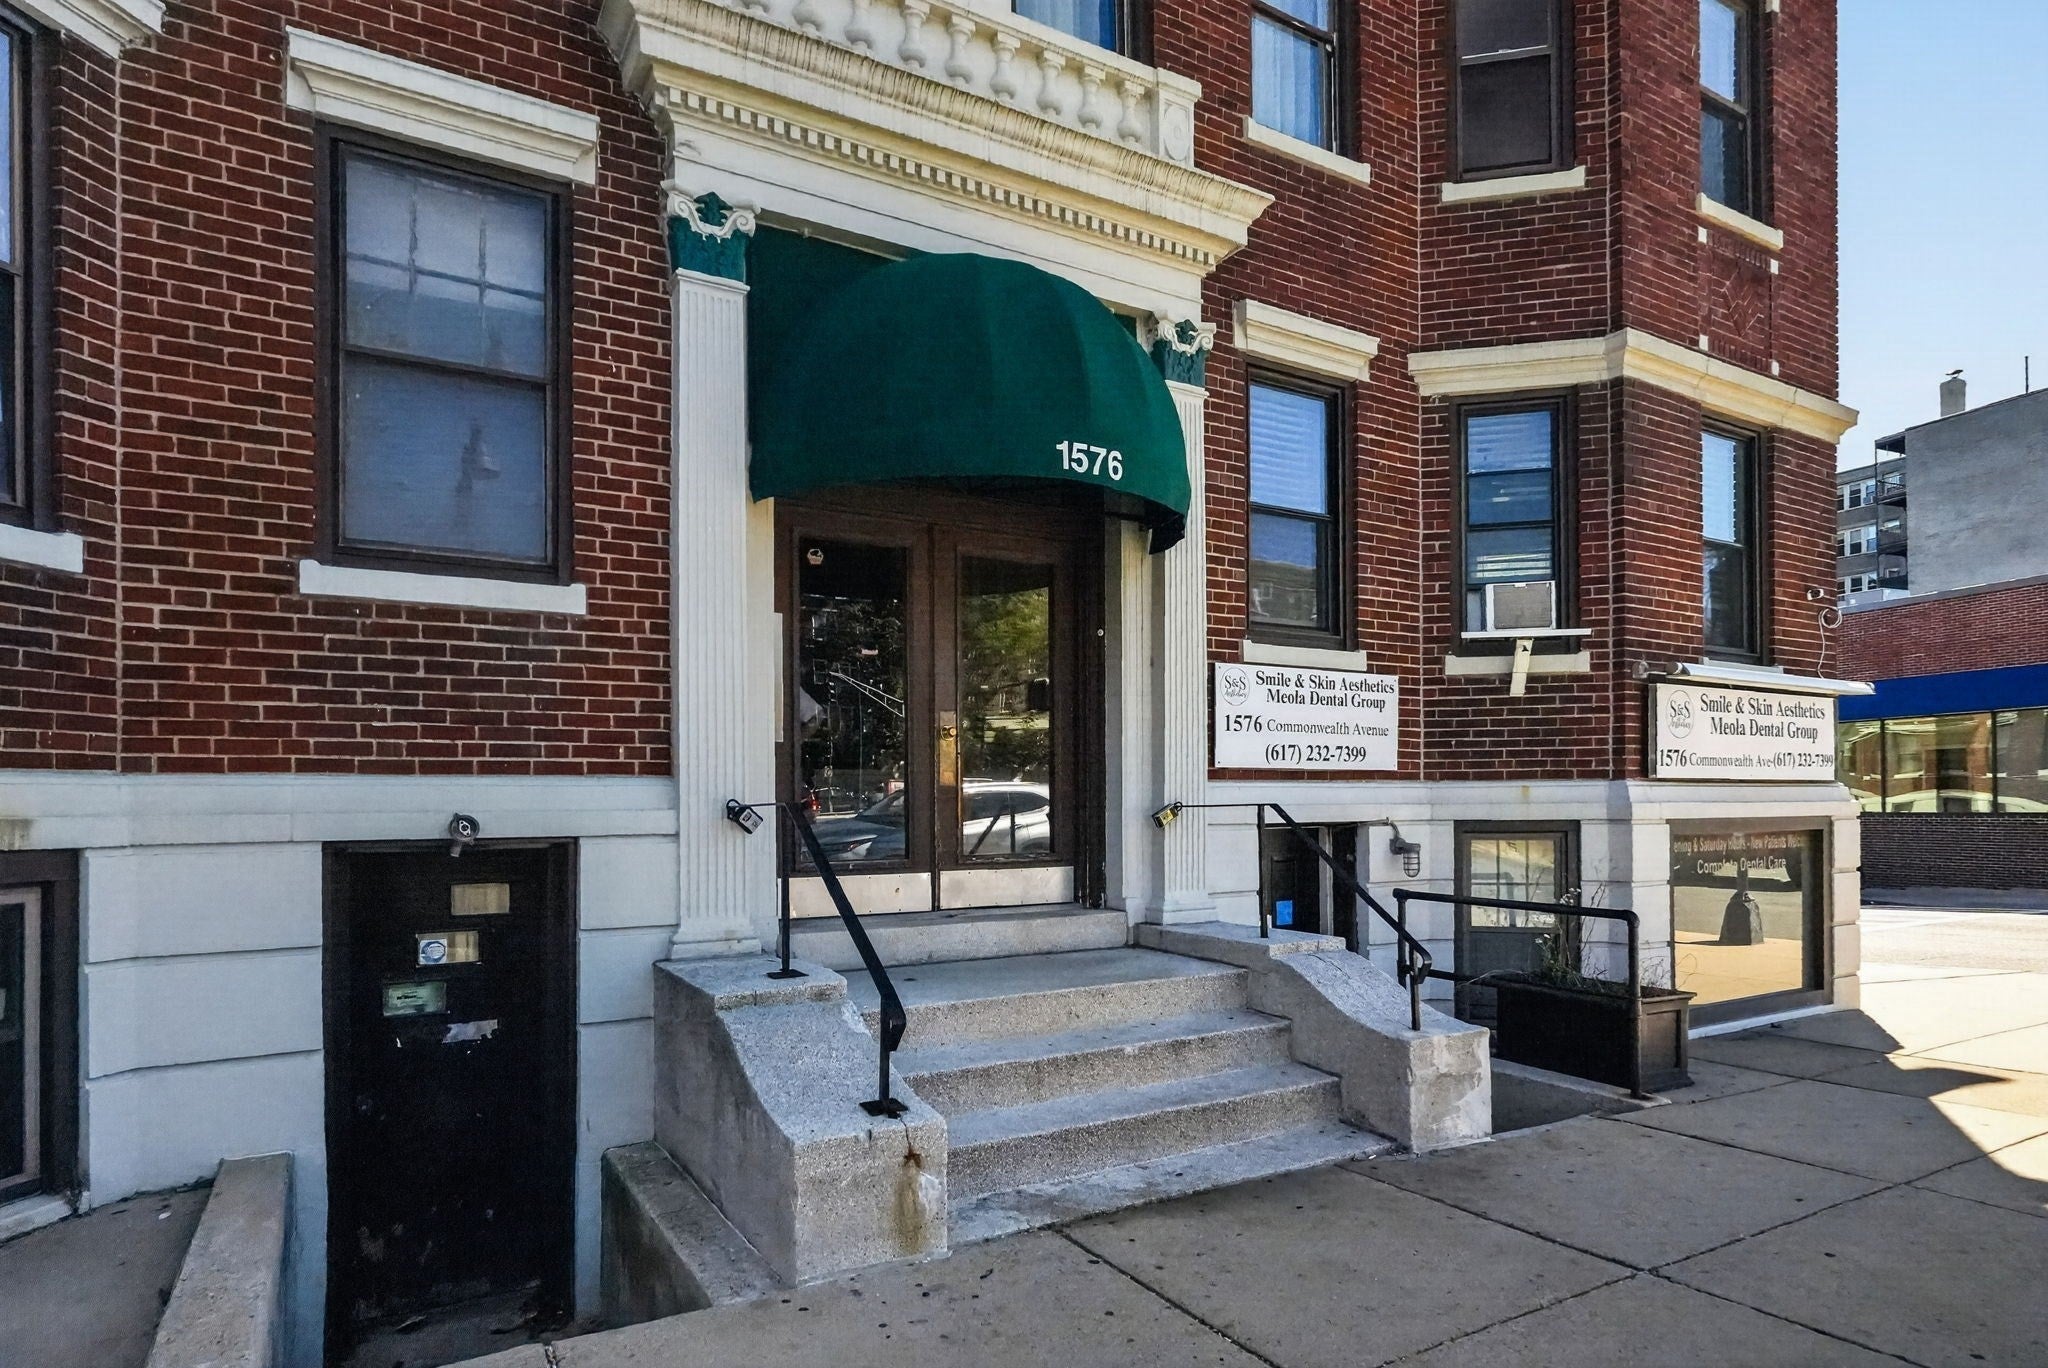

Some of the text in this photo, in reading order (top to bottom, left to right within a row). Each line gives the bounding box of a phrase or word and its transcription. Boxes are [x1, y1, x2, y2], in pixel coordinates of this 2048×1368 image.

[1055, 440, 1123, 481] 1576
[1225, 674, 1247, 690] S&S
[1255, 670, 1395, 694] Smile & Skin Aesthetics
[1266, 689, 1306, 705] Meola
[1309, 691, 1348, 707] Dental
[1351, 693, 1386, 712] Group
[1669, 700, 1691, 719] S&S
[1700, 693, 1826, 720] Smile & Skin Aesthetics
[1224, 714, 1389, 737] 1576 Commonwealth Avenue
[1710, 717, 1746, 736] Meola
[1749, 719, 1784, 738] Dental
[1787, 722, 1818, 743] Group
[1265, 743, 1367, 764] (617) 232-7399
[1660, 749, 1687, 767] 1576
[1689, 752, 1753, 768] Commonwealth
[1797, 752, 1834, 767] 232-7399
[1700, 837, 1728, 854] Saturday
[1740, 856, 1767, 872] Dental
[1768, 855, 1786, 870] Care
